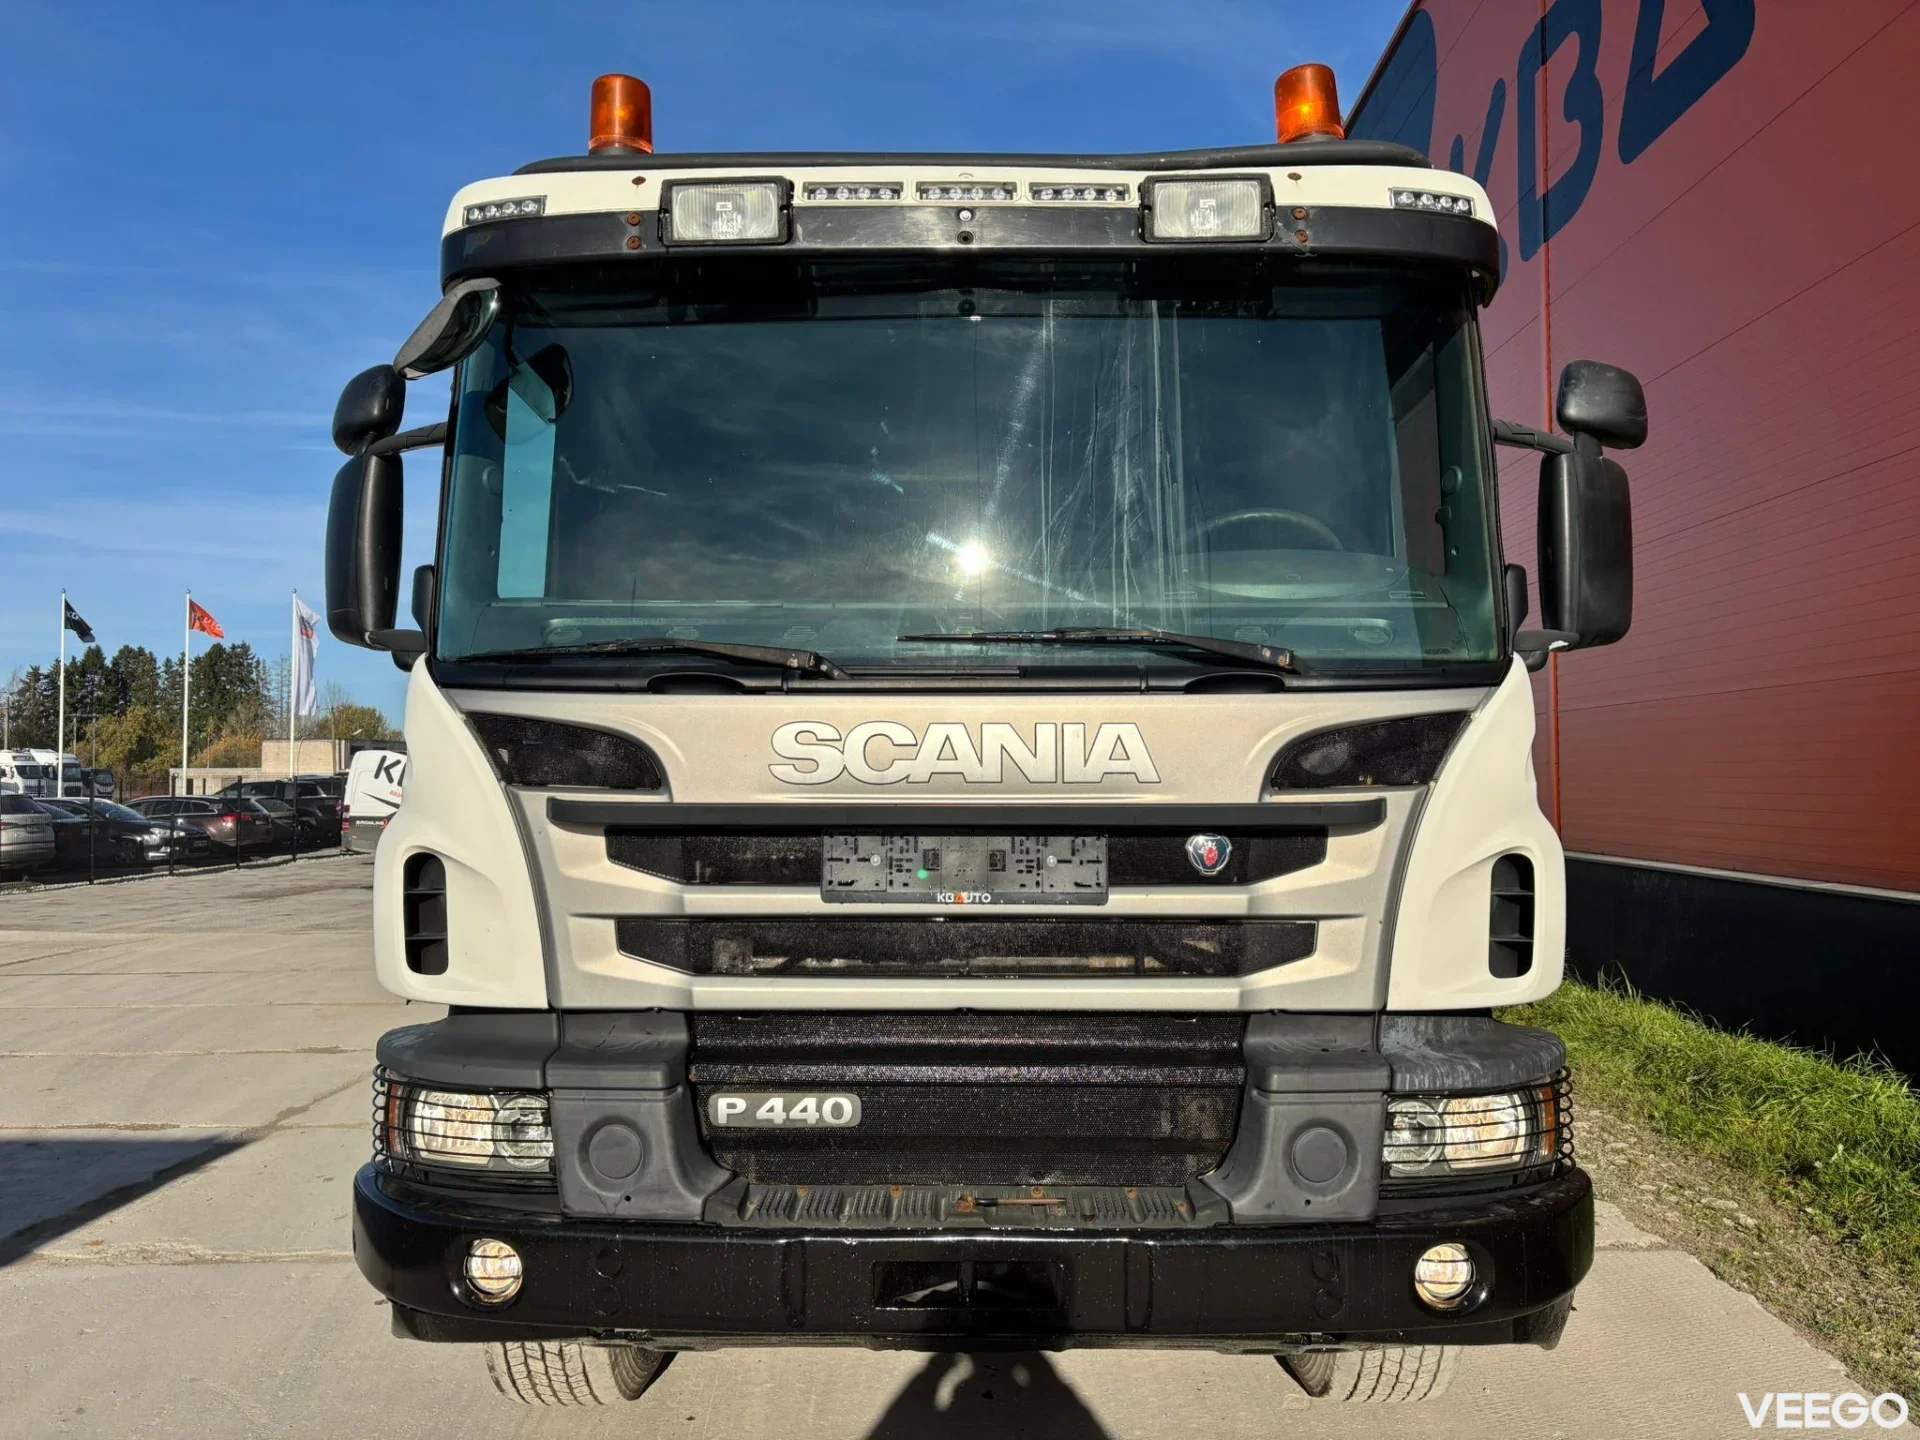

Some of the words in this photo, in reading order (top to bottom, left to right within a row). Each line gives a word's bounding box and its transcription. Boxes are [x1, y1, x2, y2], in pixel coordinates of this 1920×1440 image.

[768, 721, 1161, 785] SCANIA
[374, 755, 407, 787] K
[937, 892, 991, 903] KBAUTO
[717, 1097, 747, 1124] P
[756, 1096, 853, 1124] 440
